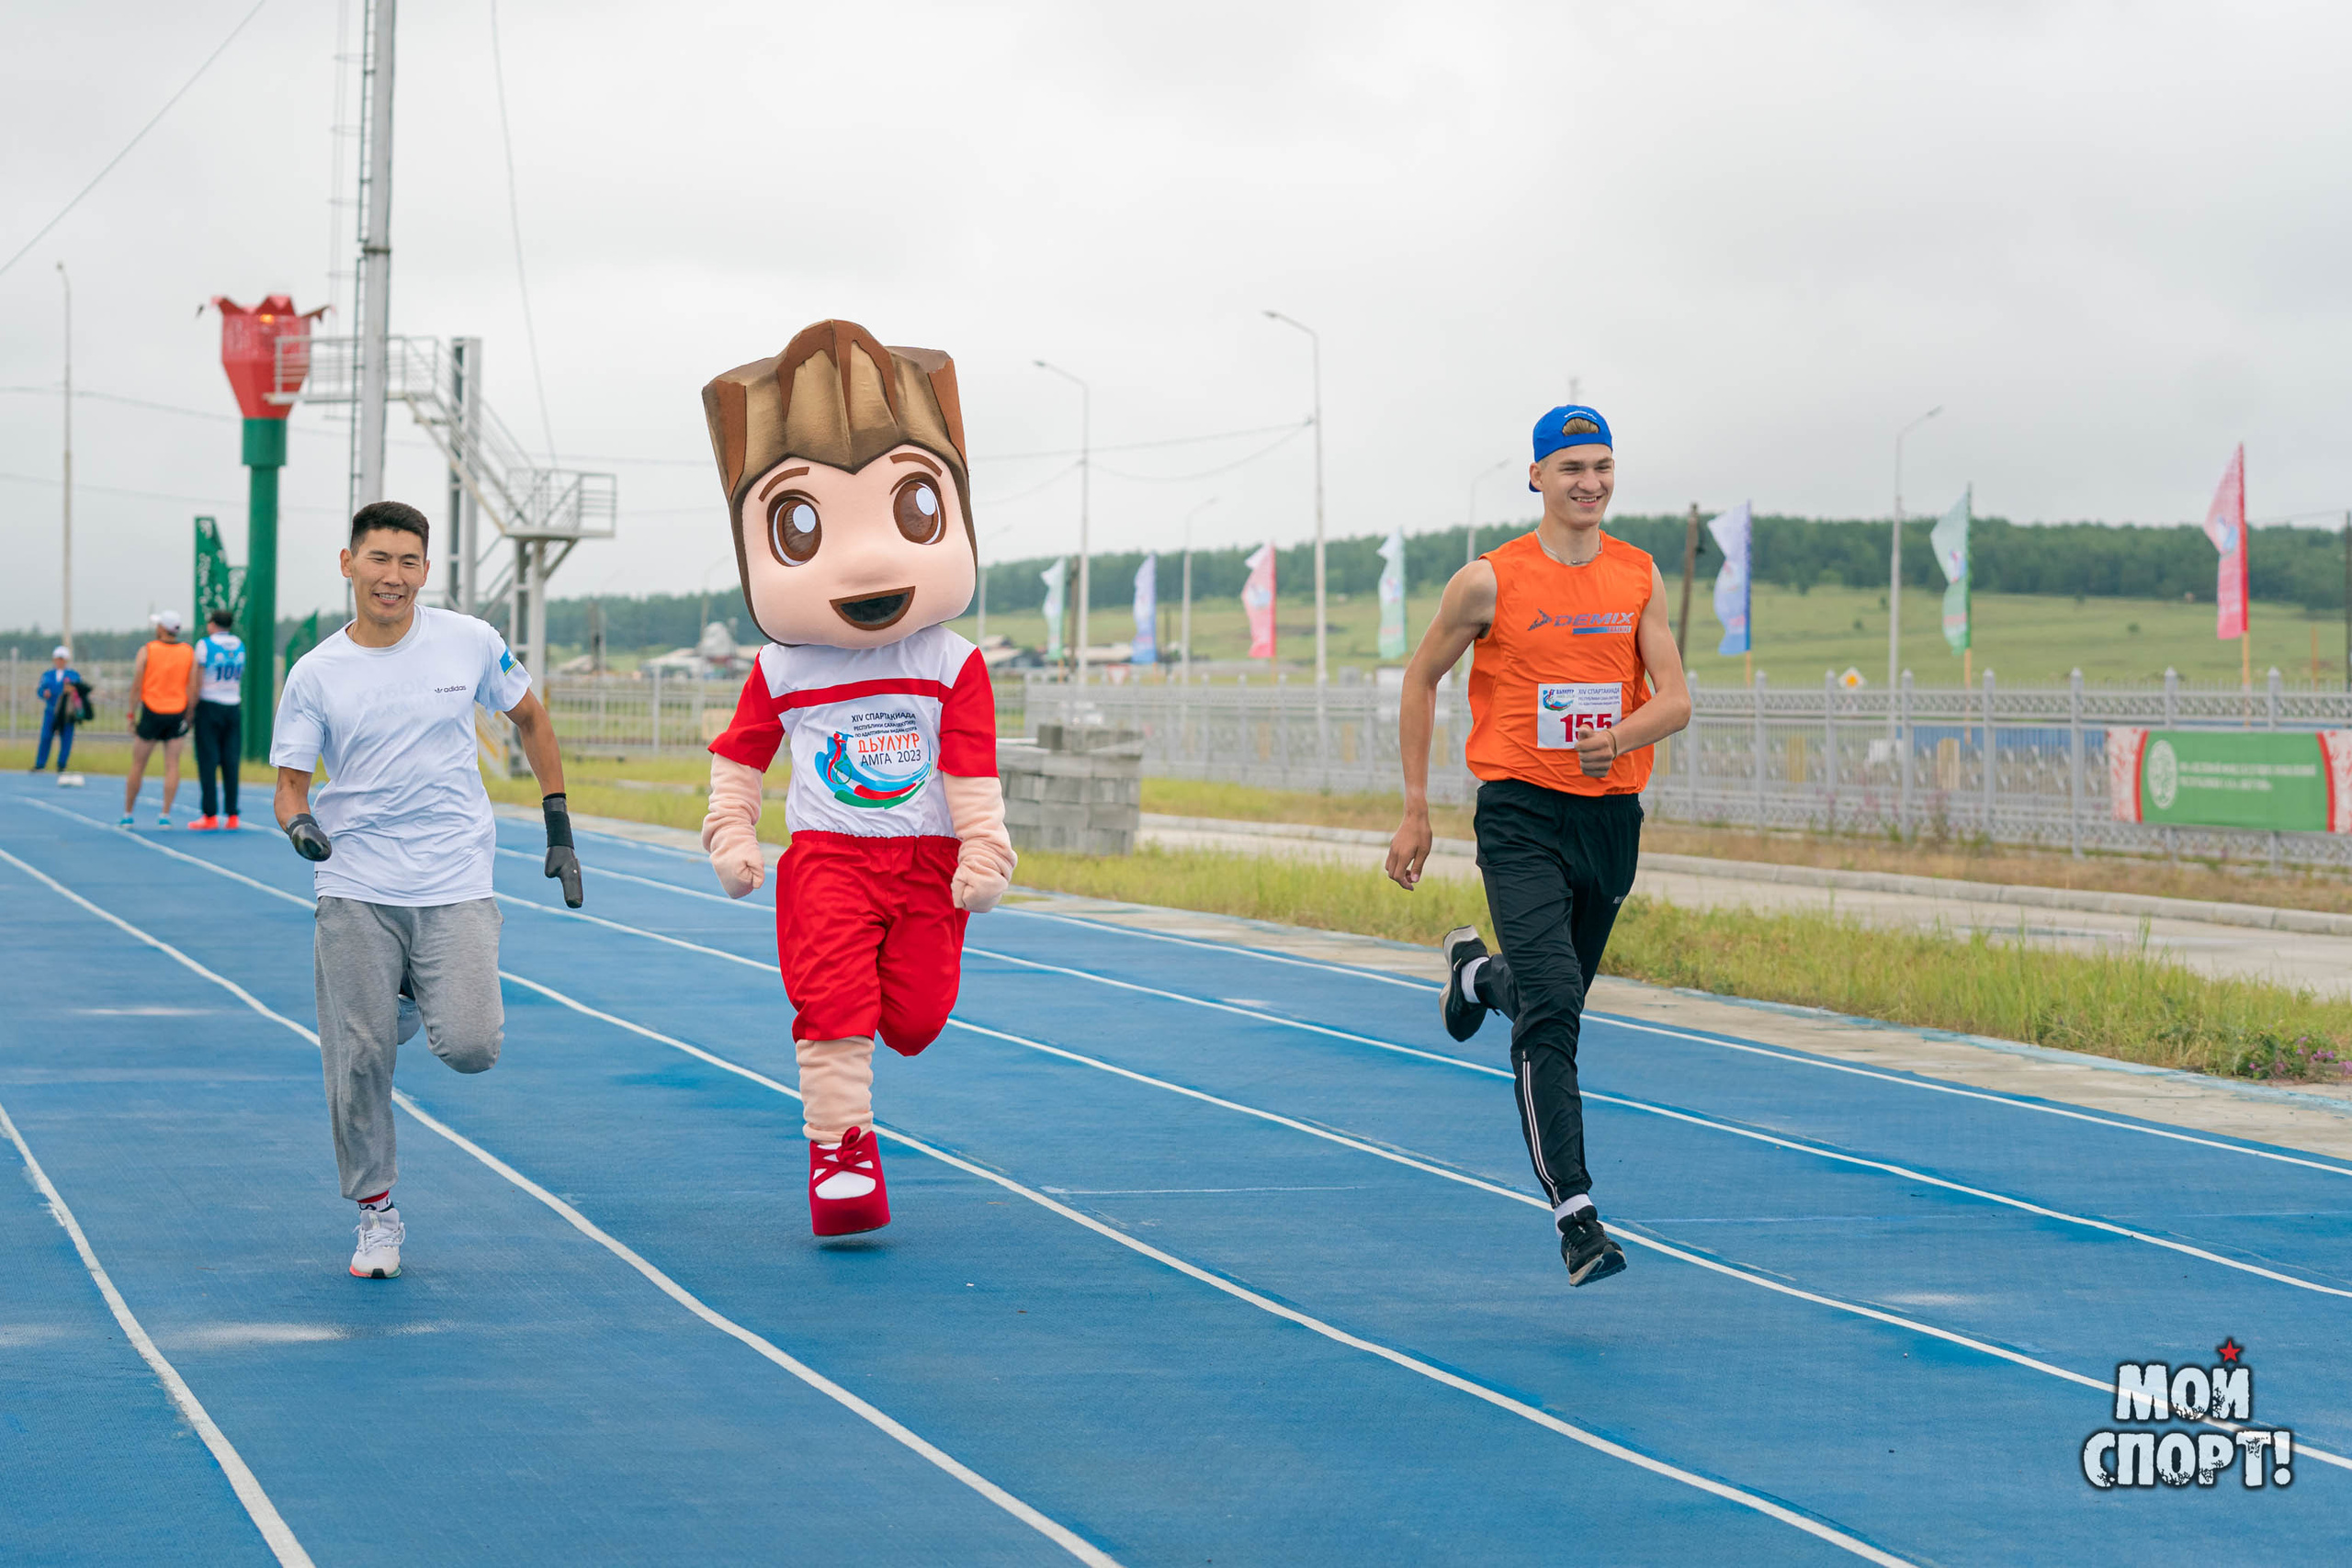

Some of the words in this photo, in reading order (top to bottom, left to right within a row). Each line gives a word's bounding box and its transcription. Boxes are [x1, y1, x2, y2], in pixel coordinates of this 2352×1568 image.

[1554, 613, 1634, 626] DEMIX
[852, 715, 864, 723] XIV
[865, 712, 916, 721] СПАРТАКИАДА
[1560, 713, 1612, 742] 155
[858, 732, 920, 753] ДЬУЛУУР
[861, 753, 892, 767] АМГА
[897, 750, 922, 762] 2023
